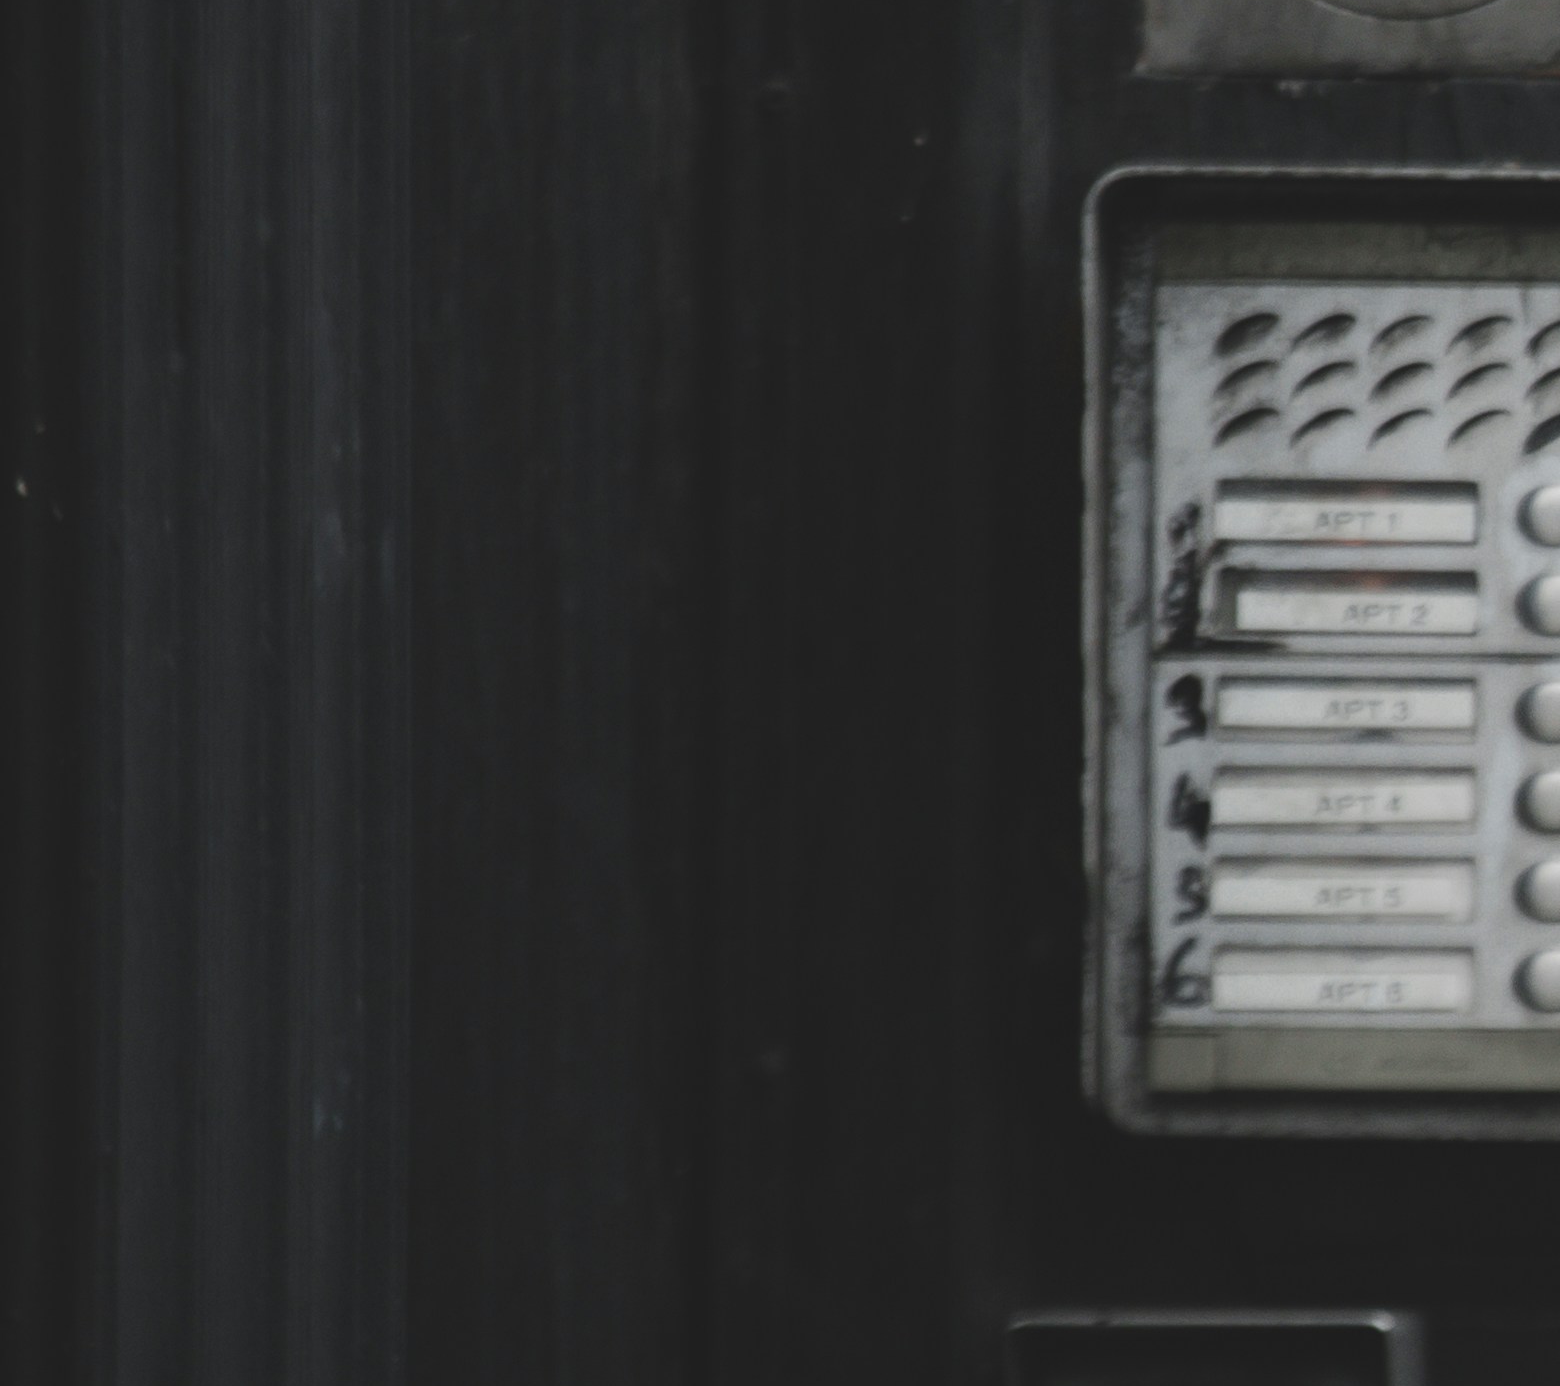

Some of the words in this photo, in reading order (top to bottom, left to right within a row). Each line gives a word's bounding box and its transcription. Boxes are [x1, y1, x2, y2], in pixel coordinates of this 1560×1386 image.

[1313, 510, 1376, 534] APT
[1341, 602, 1403, 626] APT
[1408, 603, 1432, 627] 2
[1321, 699, 1385, 722] APT
[1391, 700, 1410, 723] 3
[1314, 793, 1376, 816] APT
[1312, 884, 1377, 908] APT
[1316, 980, 1378, 1004] APT
